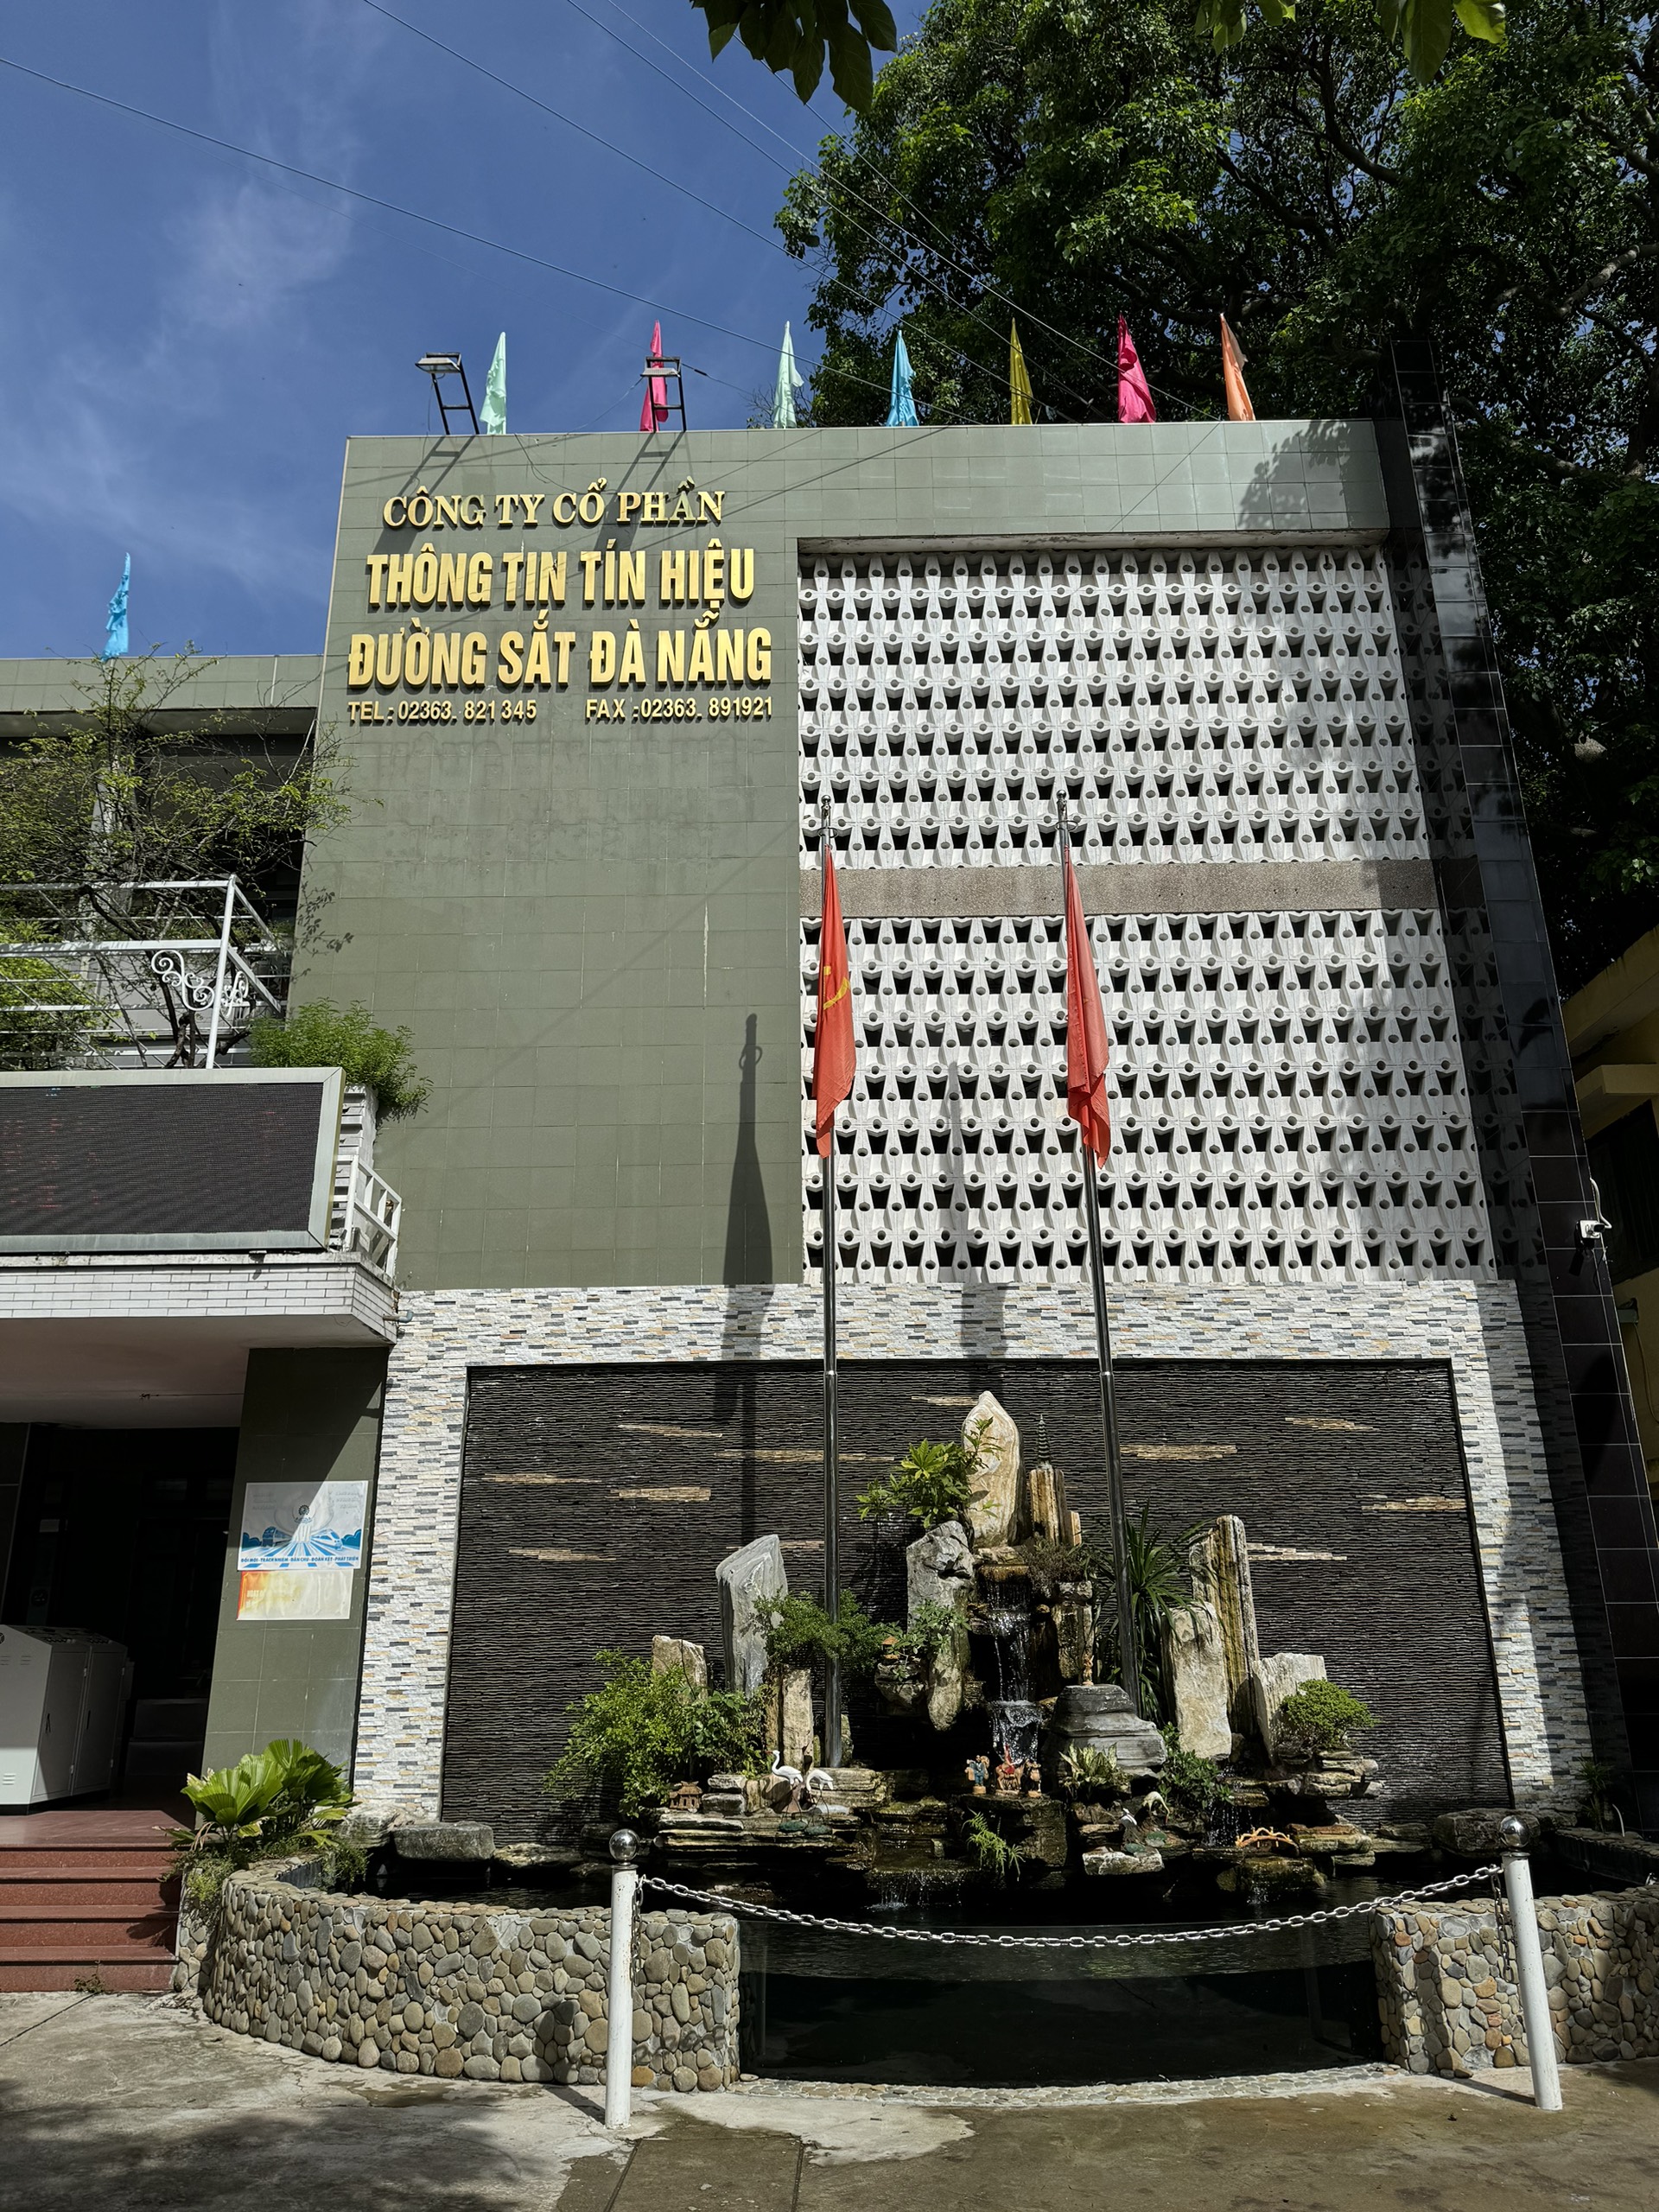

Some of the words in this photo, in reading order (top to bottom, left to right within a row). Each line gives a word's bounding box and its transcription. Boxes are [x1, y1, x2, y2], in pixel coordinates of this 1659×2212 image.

[383, 486, 486, 527] CÔNG
[495, 493, 545, 525] TY
[553, 477, 607, 524] CỔ
[616, 476, 726, 524] PHẦN
[366, 542, 493, 606] THÔNG
[502, 551, 568, 605] TIN
[580, 538, 646, 605] TÍN
[660, 537, 755, 608] HIỆU
[348, 617, 488, 688] ĐƯỜNG
[498, 609, 576, 688] SẮT
[589, 619, 646, 686] ĐÀ
[658, 610, 772, 685] NẴNG
[398, 700, 458, 721] 02363.
[464, 699, 496, 720] 821
[501, 699, 537, 720] 345
[709, 696, 772, 716] 891921
